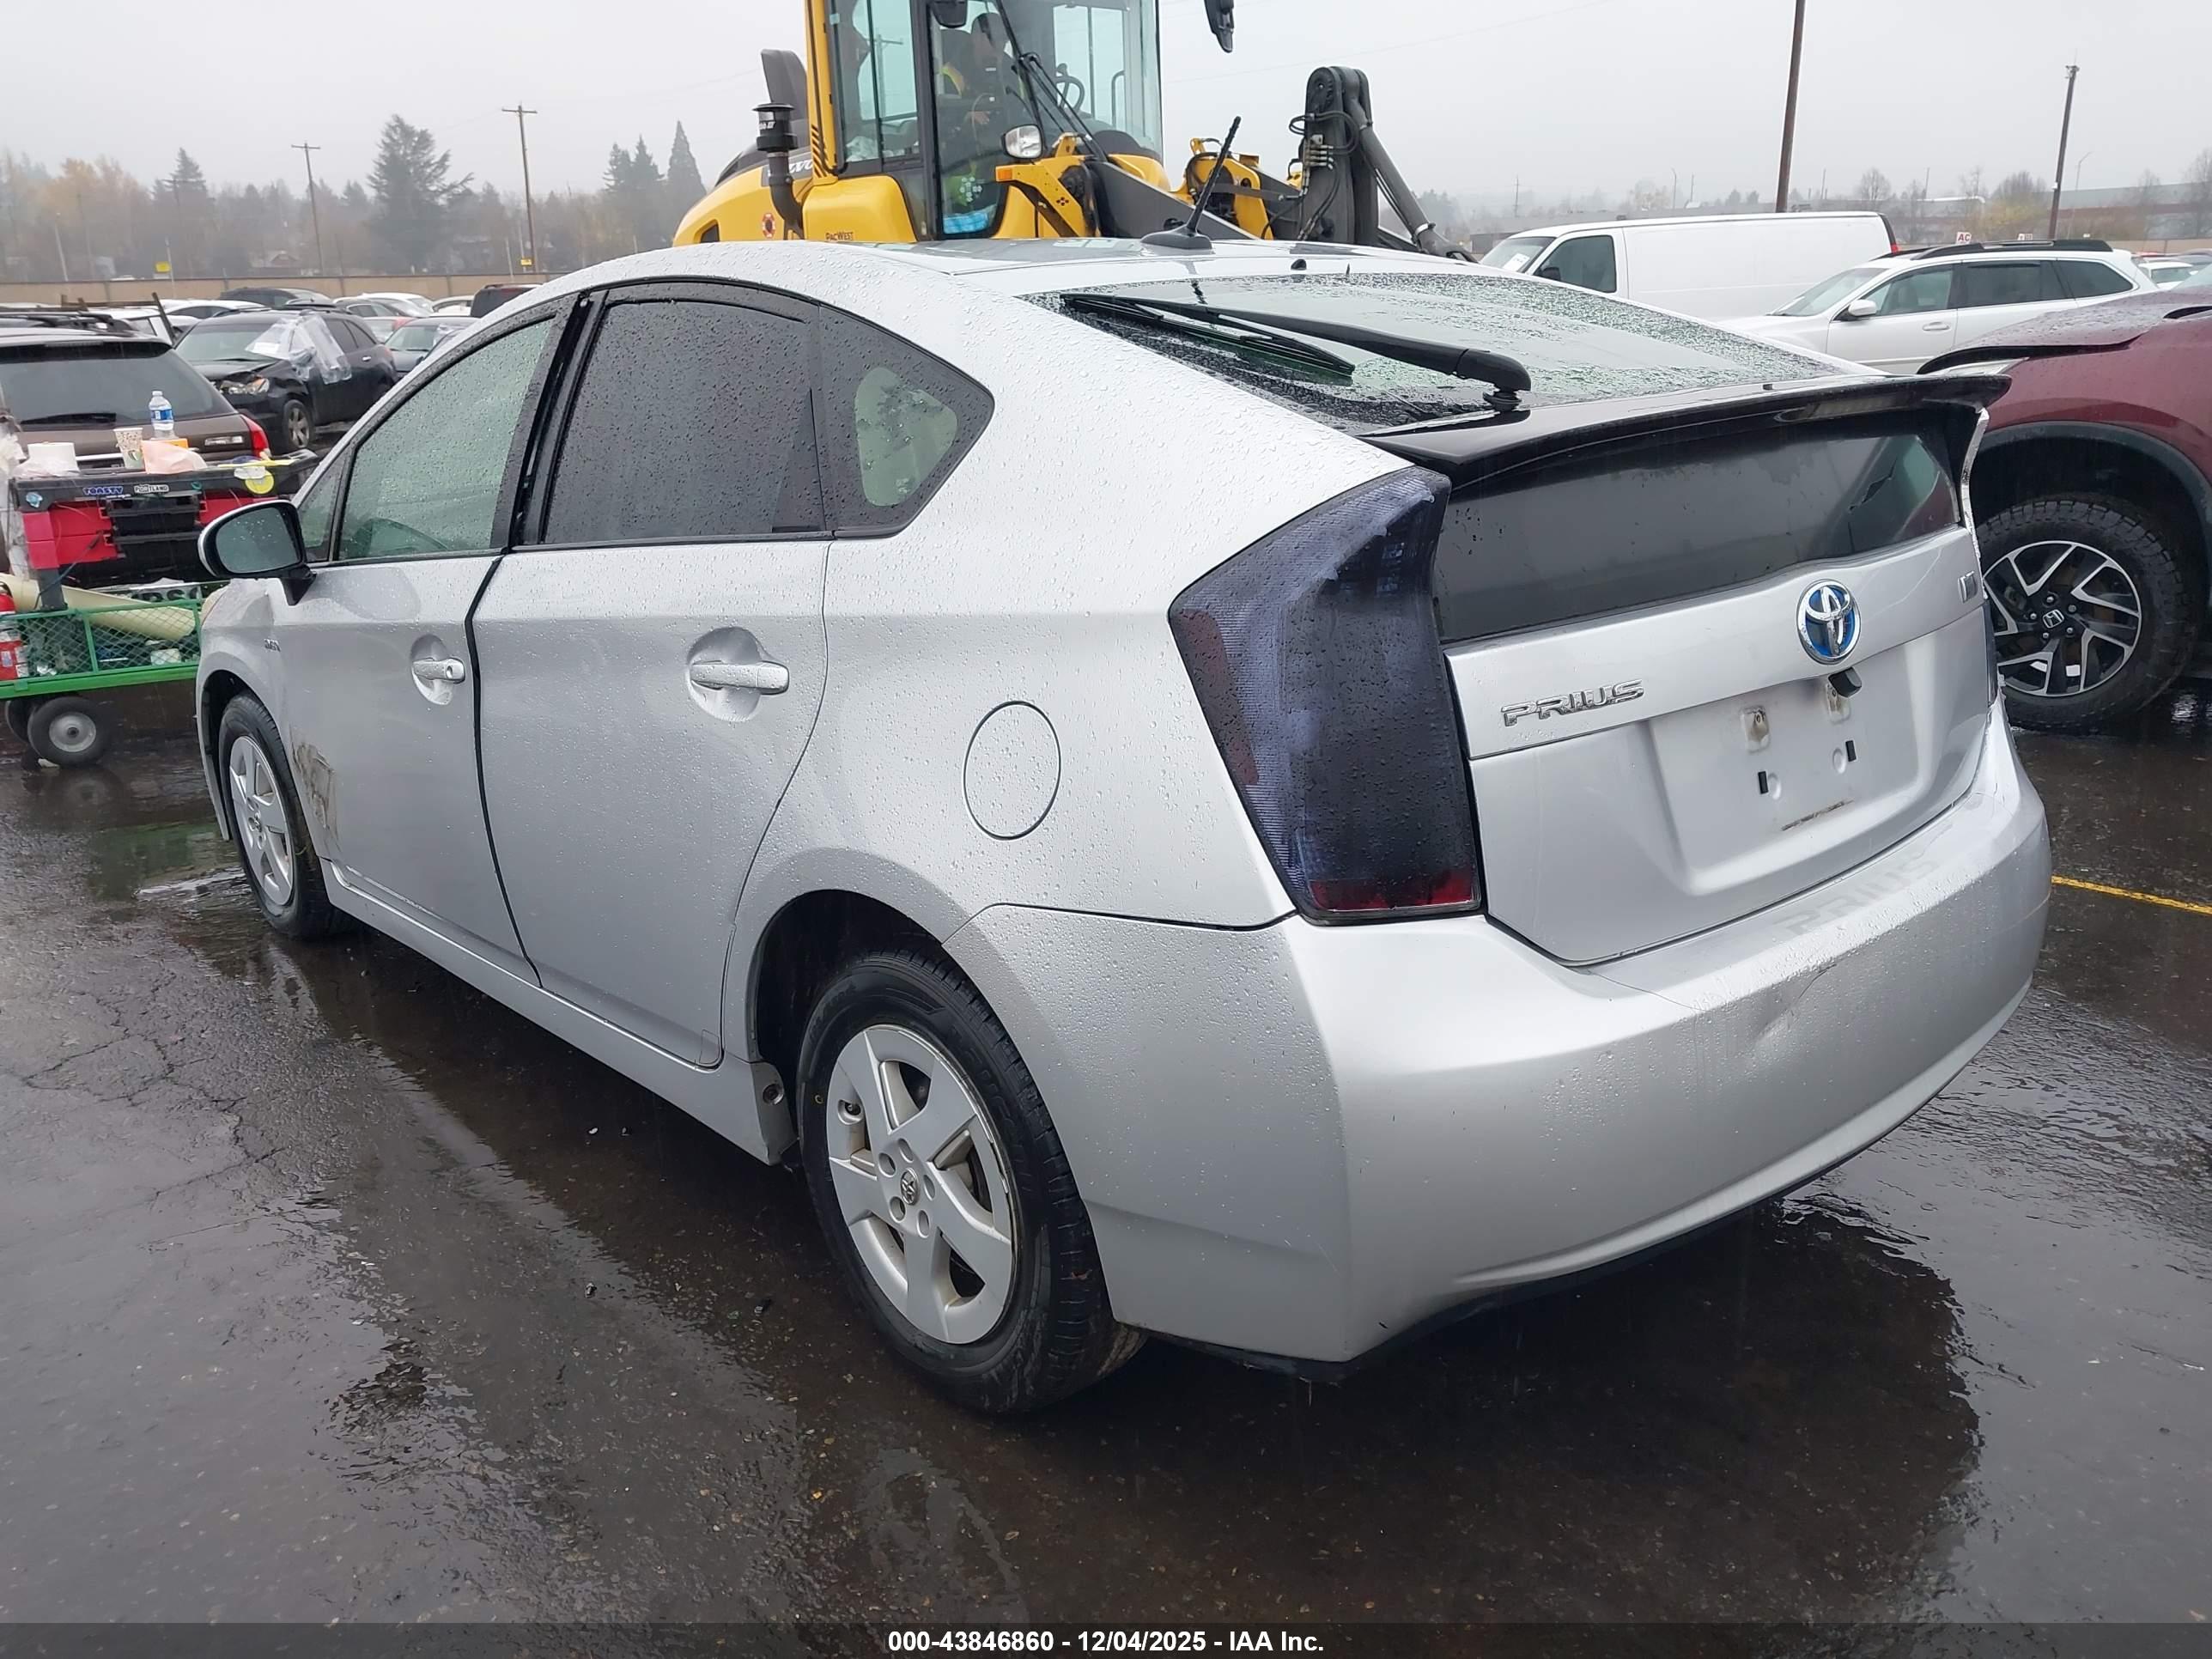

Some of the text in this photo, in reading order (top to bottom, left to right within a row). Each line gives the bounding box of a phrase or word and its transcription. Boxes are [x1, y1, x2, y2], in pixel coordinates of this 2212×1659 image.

[83, 486, 124, 495] TOASTY
[134, 484, 169, 494] PORTLAND
[1501, 678, 1644, 726] PRIUS
